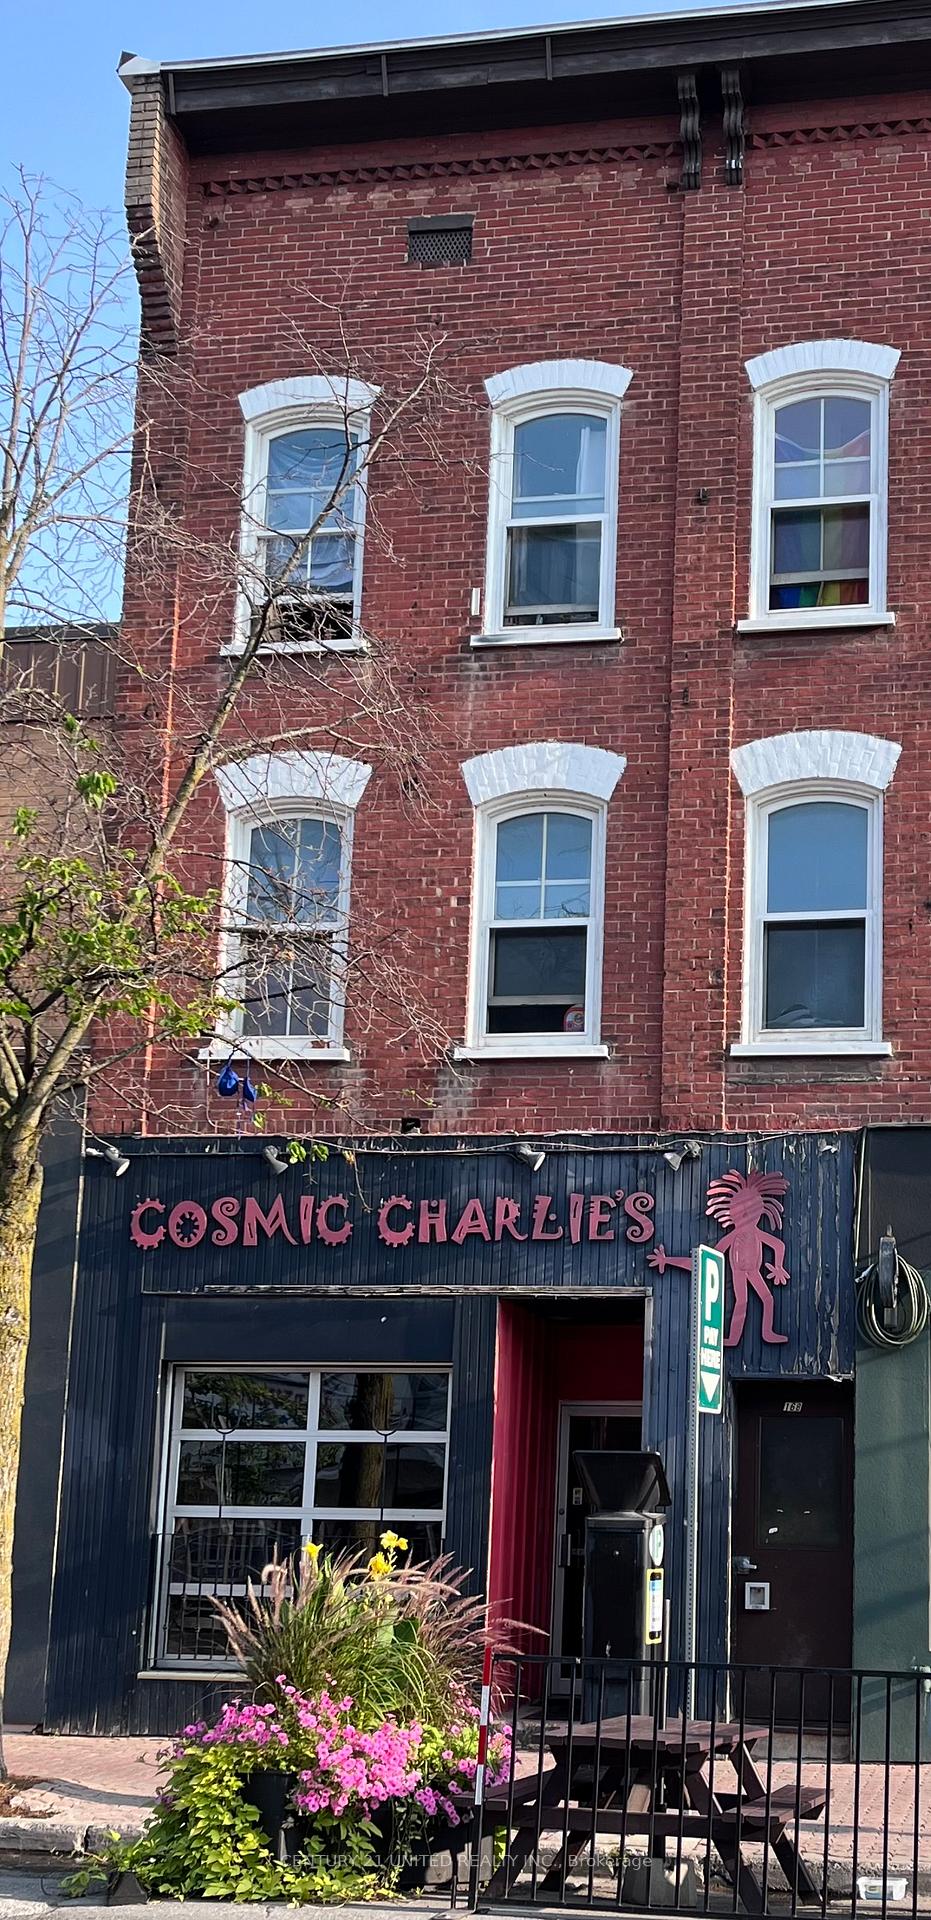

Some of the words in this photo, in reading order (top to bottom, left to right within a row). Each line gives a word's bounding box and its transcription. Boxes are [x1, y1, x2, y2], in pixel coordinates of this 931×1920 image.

[130, 1193, 353, 1249] COSMIC
[377, 1189, 654, 1247] CHARLIE'S
[705, 1257, 719, 1321] P
[703, 1325, 719, 1347] PAY
[700, 1346, 721, 1370] HERE
